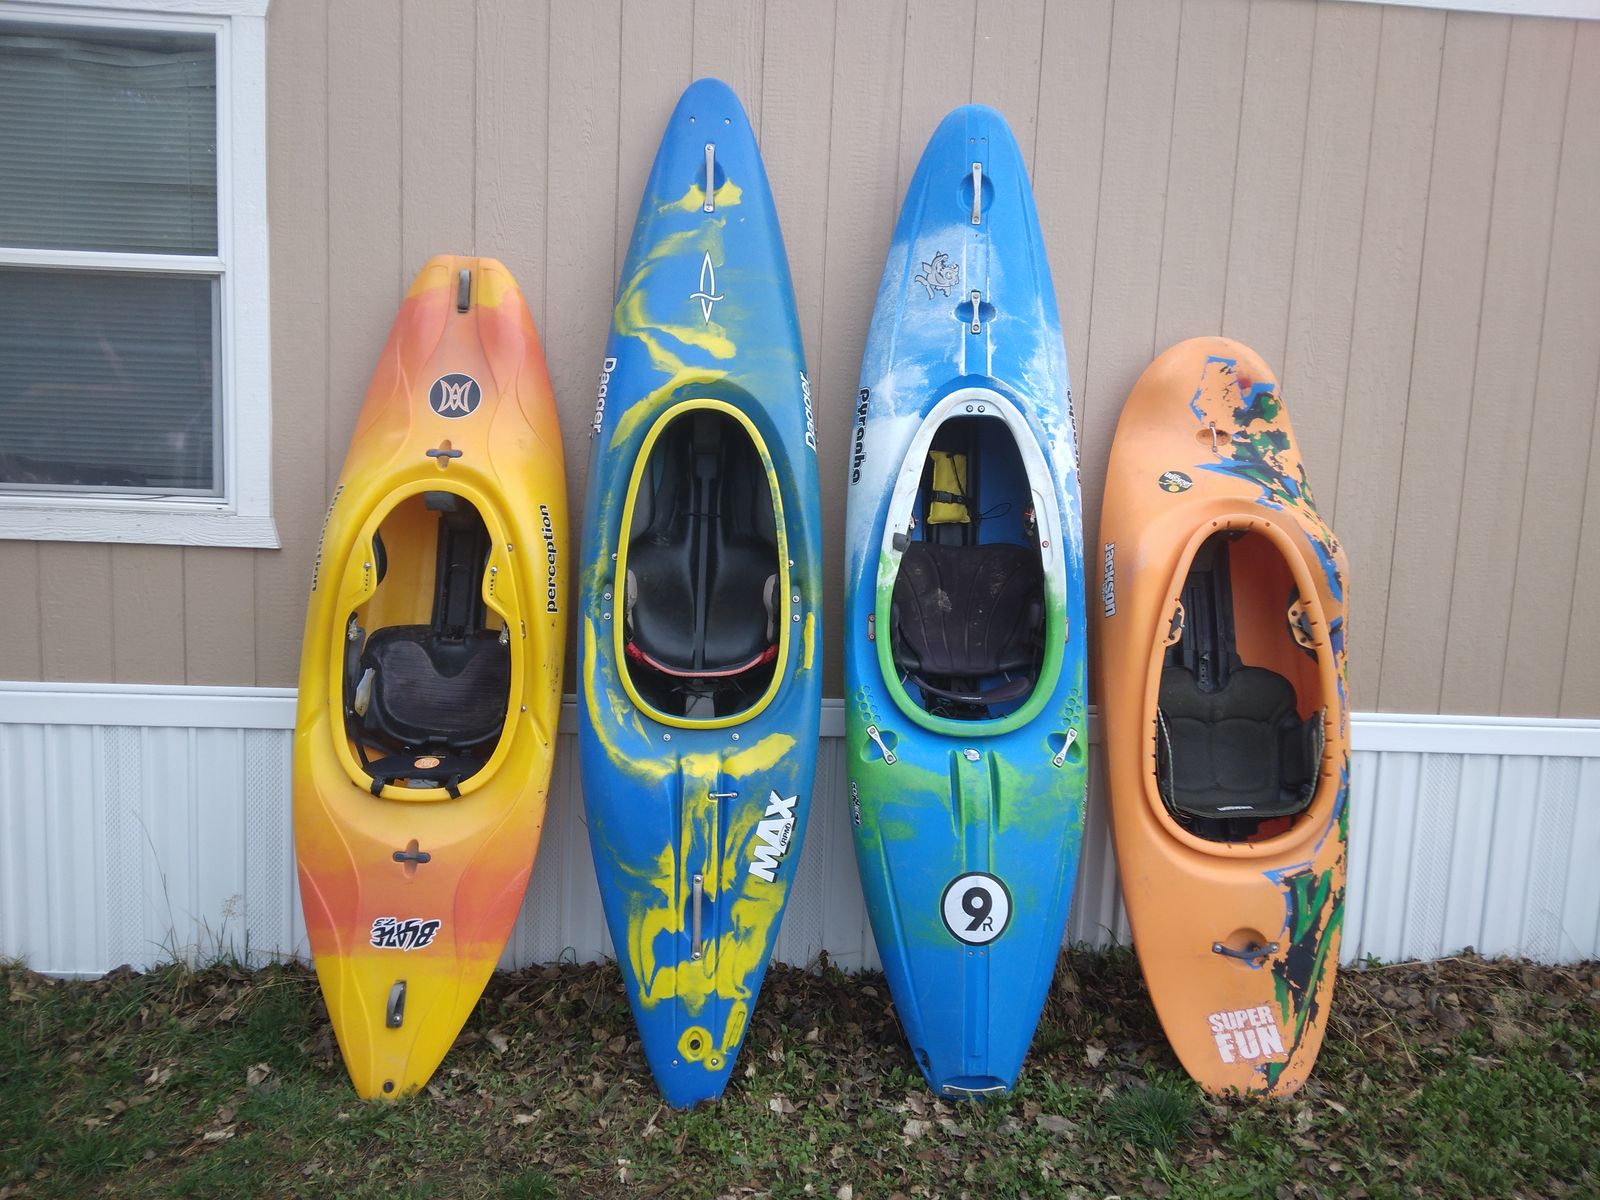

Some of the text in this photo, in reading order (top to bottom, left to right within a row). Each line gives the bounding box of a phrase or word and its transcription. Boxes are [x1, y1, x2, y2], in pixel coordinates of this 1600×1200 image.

[540, 504, 558, 613] perception
[748, 789, 798, 883] MAX
[371, 920, 441, 951] BLAZE
[1208, 1006, 1276, 1032] SUPER
[1214, 1024, 1285, 1063] FUN
